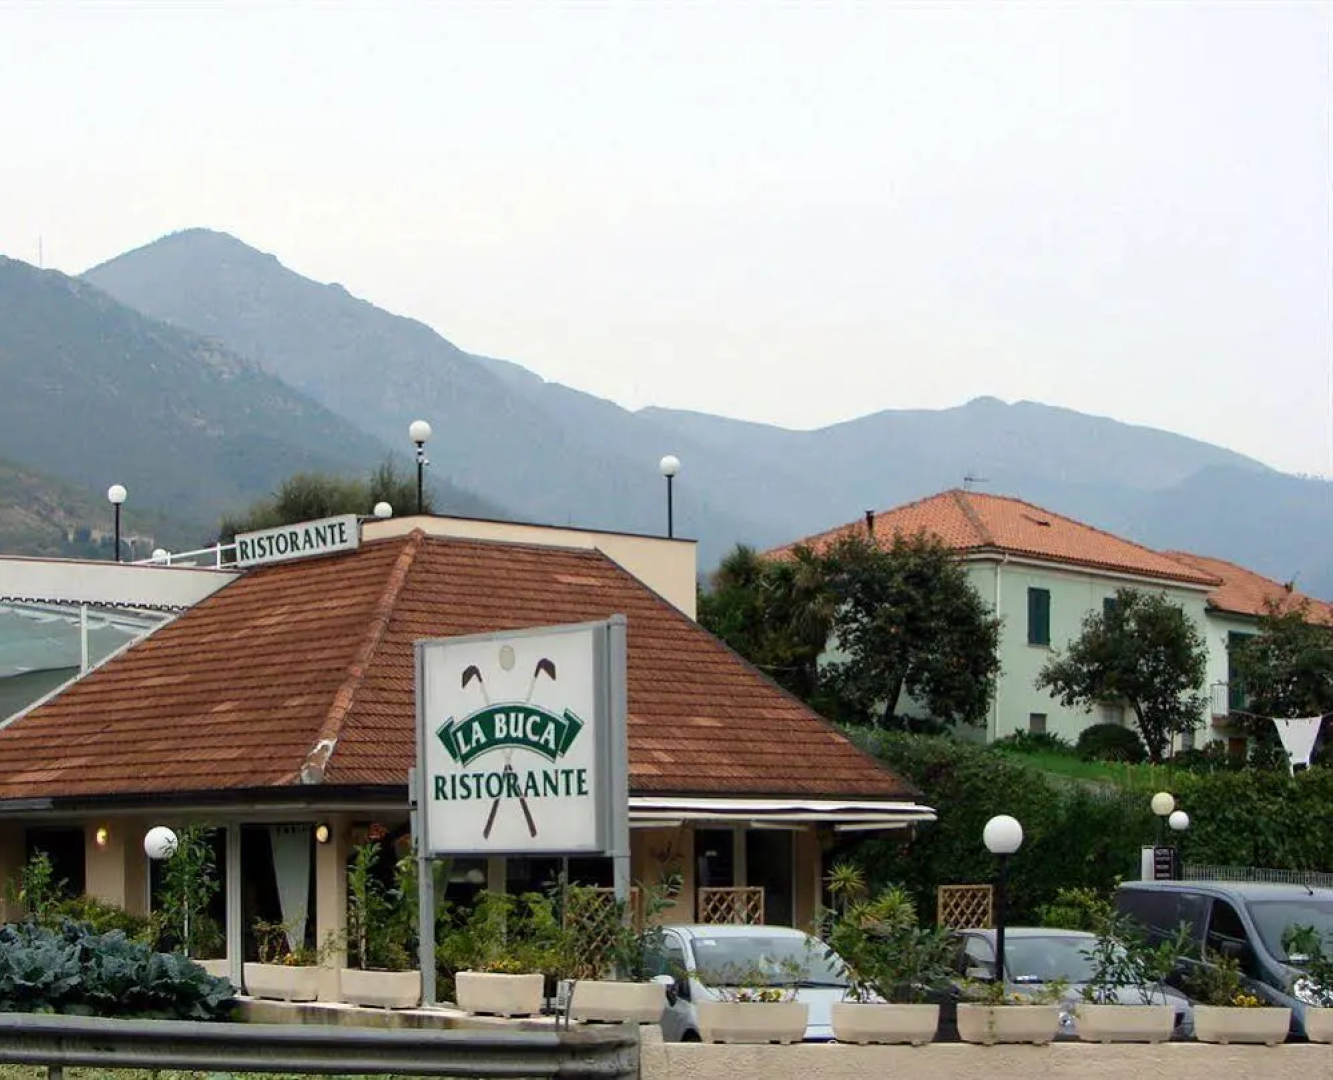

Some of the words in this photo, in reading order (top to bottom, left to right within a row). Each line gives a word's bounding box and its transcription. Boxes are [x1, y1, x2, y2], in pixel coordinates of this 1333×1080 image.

[239, 522, 347, 561] RISTORANTE
[456, 721, 486, 754] LA
[494, 712, 556, 750] BUCA
[434, 769, 589, 801] RISTORANTE
